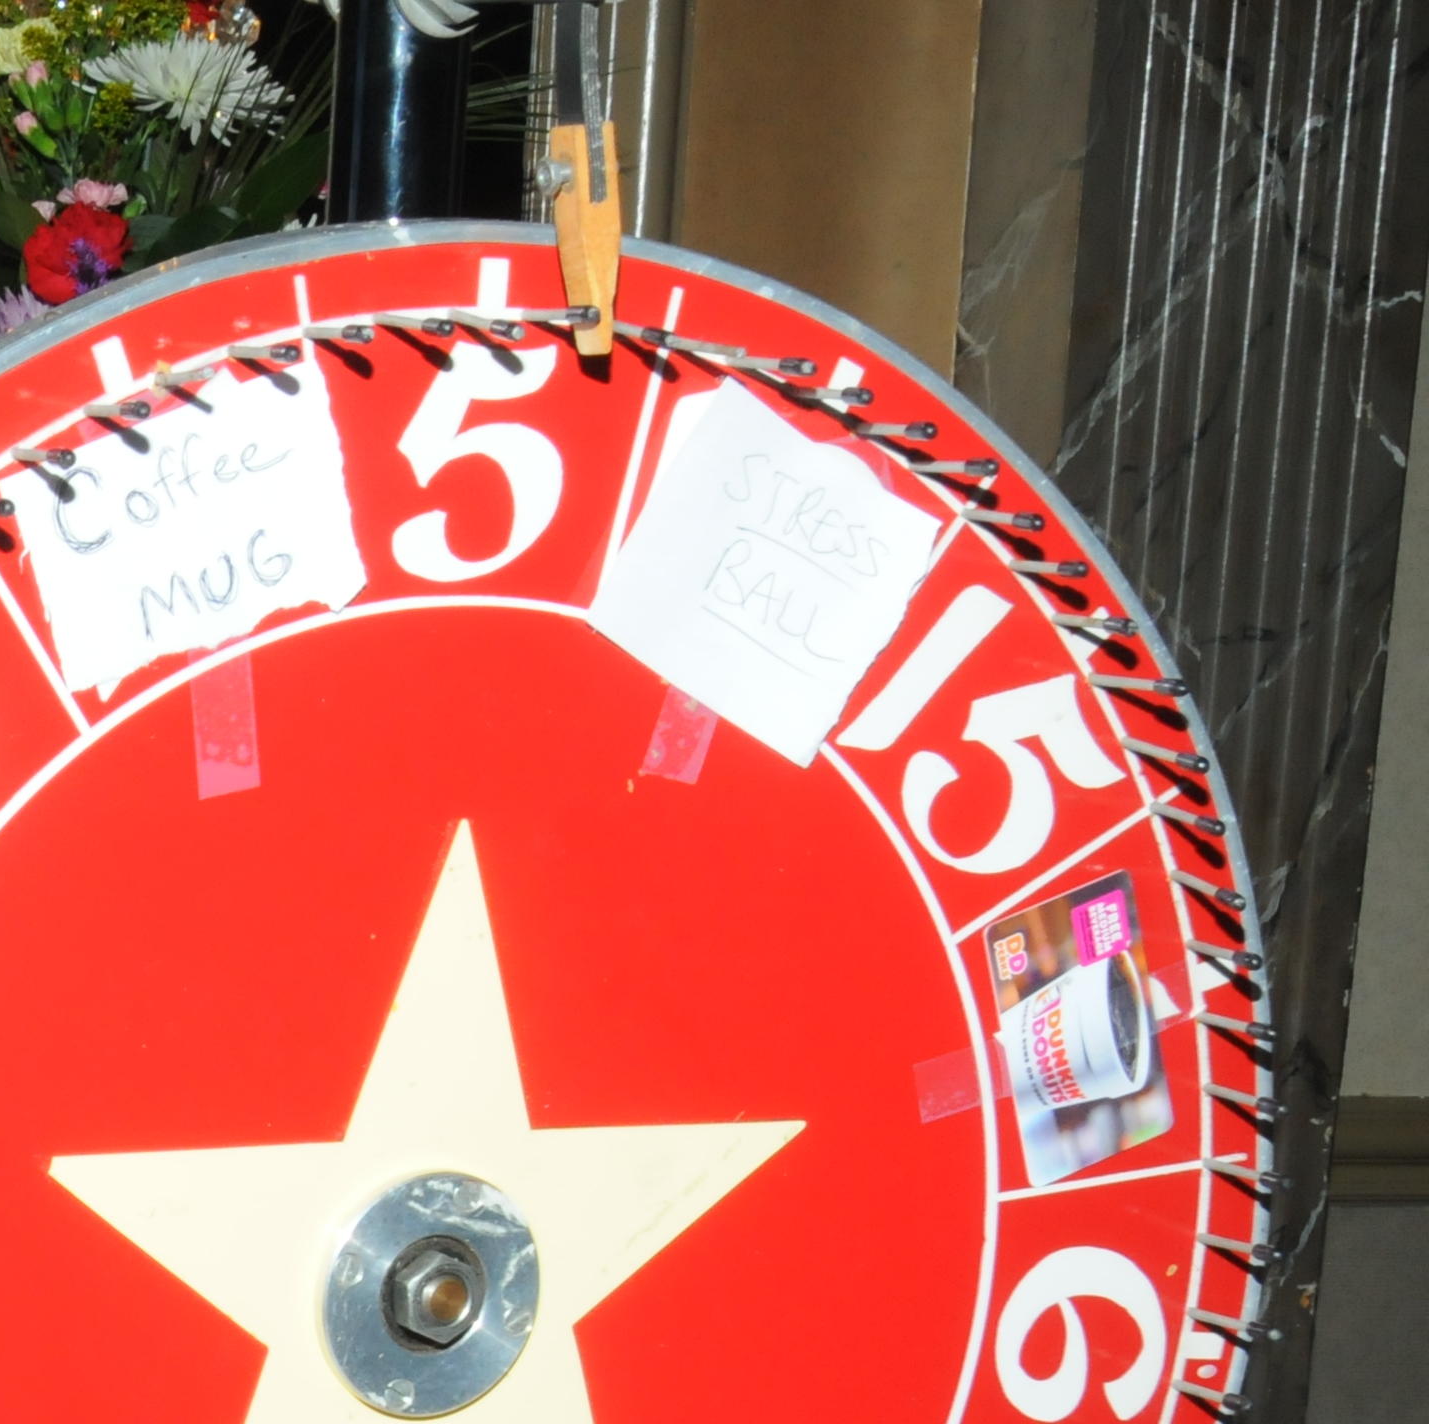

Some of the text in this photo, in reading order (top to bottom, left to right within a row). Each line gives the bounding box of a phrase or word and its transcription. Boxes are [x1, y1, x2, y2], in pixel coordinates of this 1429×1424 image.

[50, 429, 291, 556] Coffee
[391, 341, 564, 582] 5
[722, 451, 891, 578] STRESS
[138, 527, 294, 641] MUG
[704, 539, 845, 666] BALL
[835, 583, 1129, 876] 15
[1031, 1015, 1071, 1105] DONUTS
